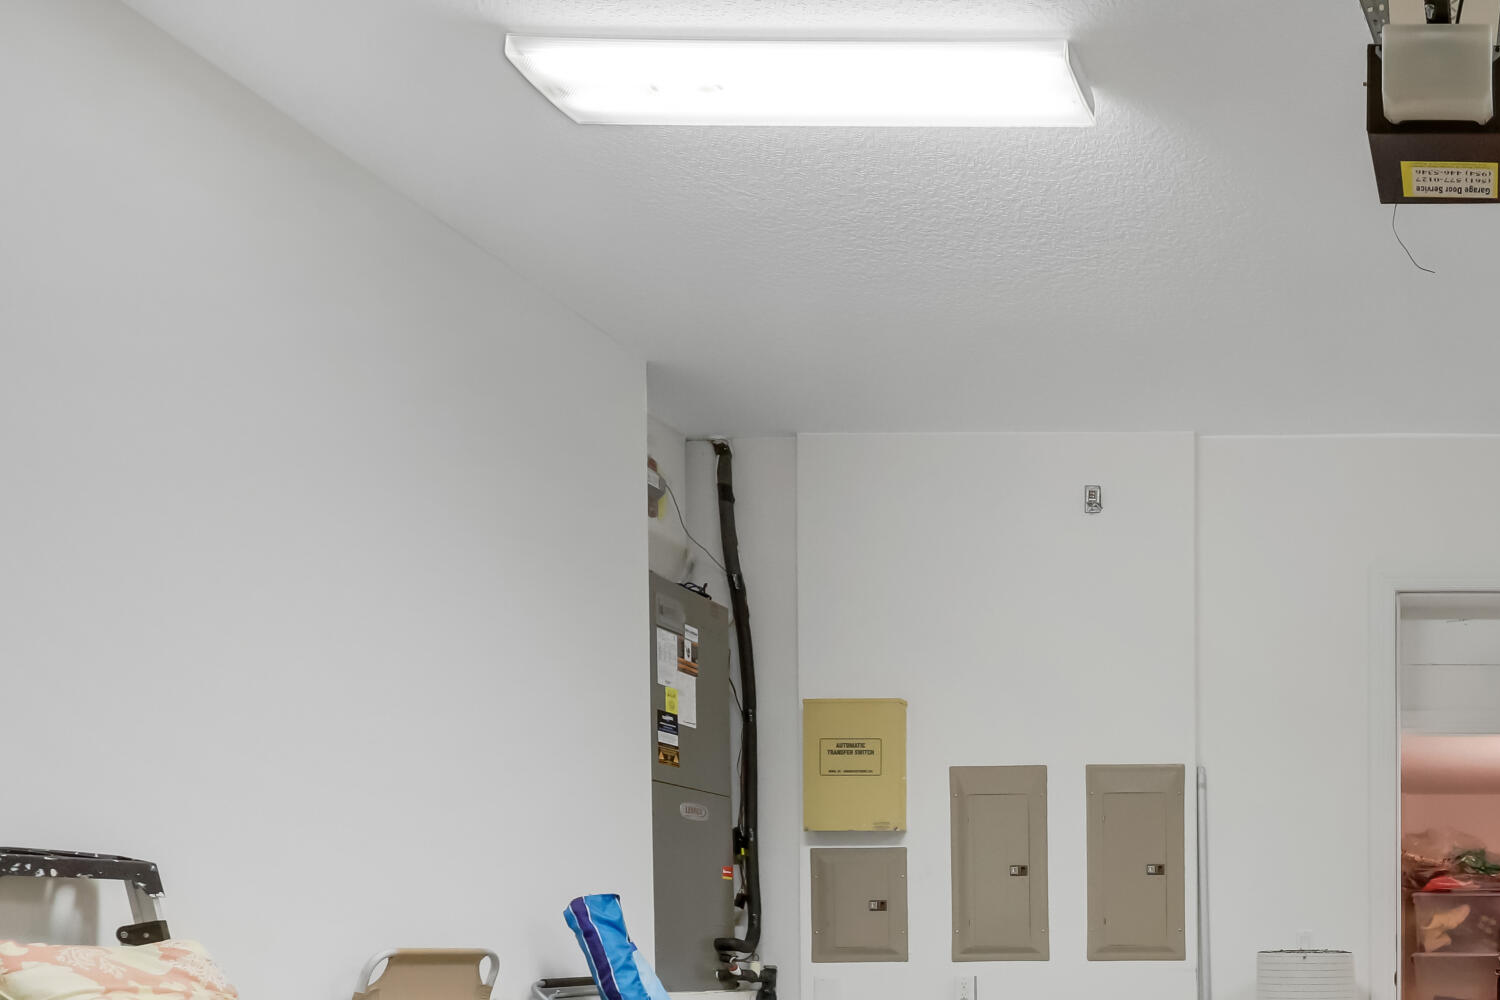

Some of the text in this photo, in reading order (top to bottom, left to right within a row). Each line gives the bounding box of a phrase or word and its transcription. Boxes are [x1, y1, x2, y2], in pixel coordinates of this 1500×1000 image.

[1416, 185, 1490, 195] Garage Door Service
